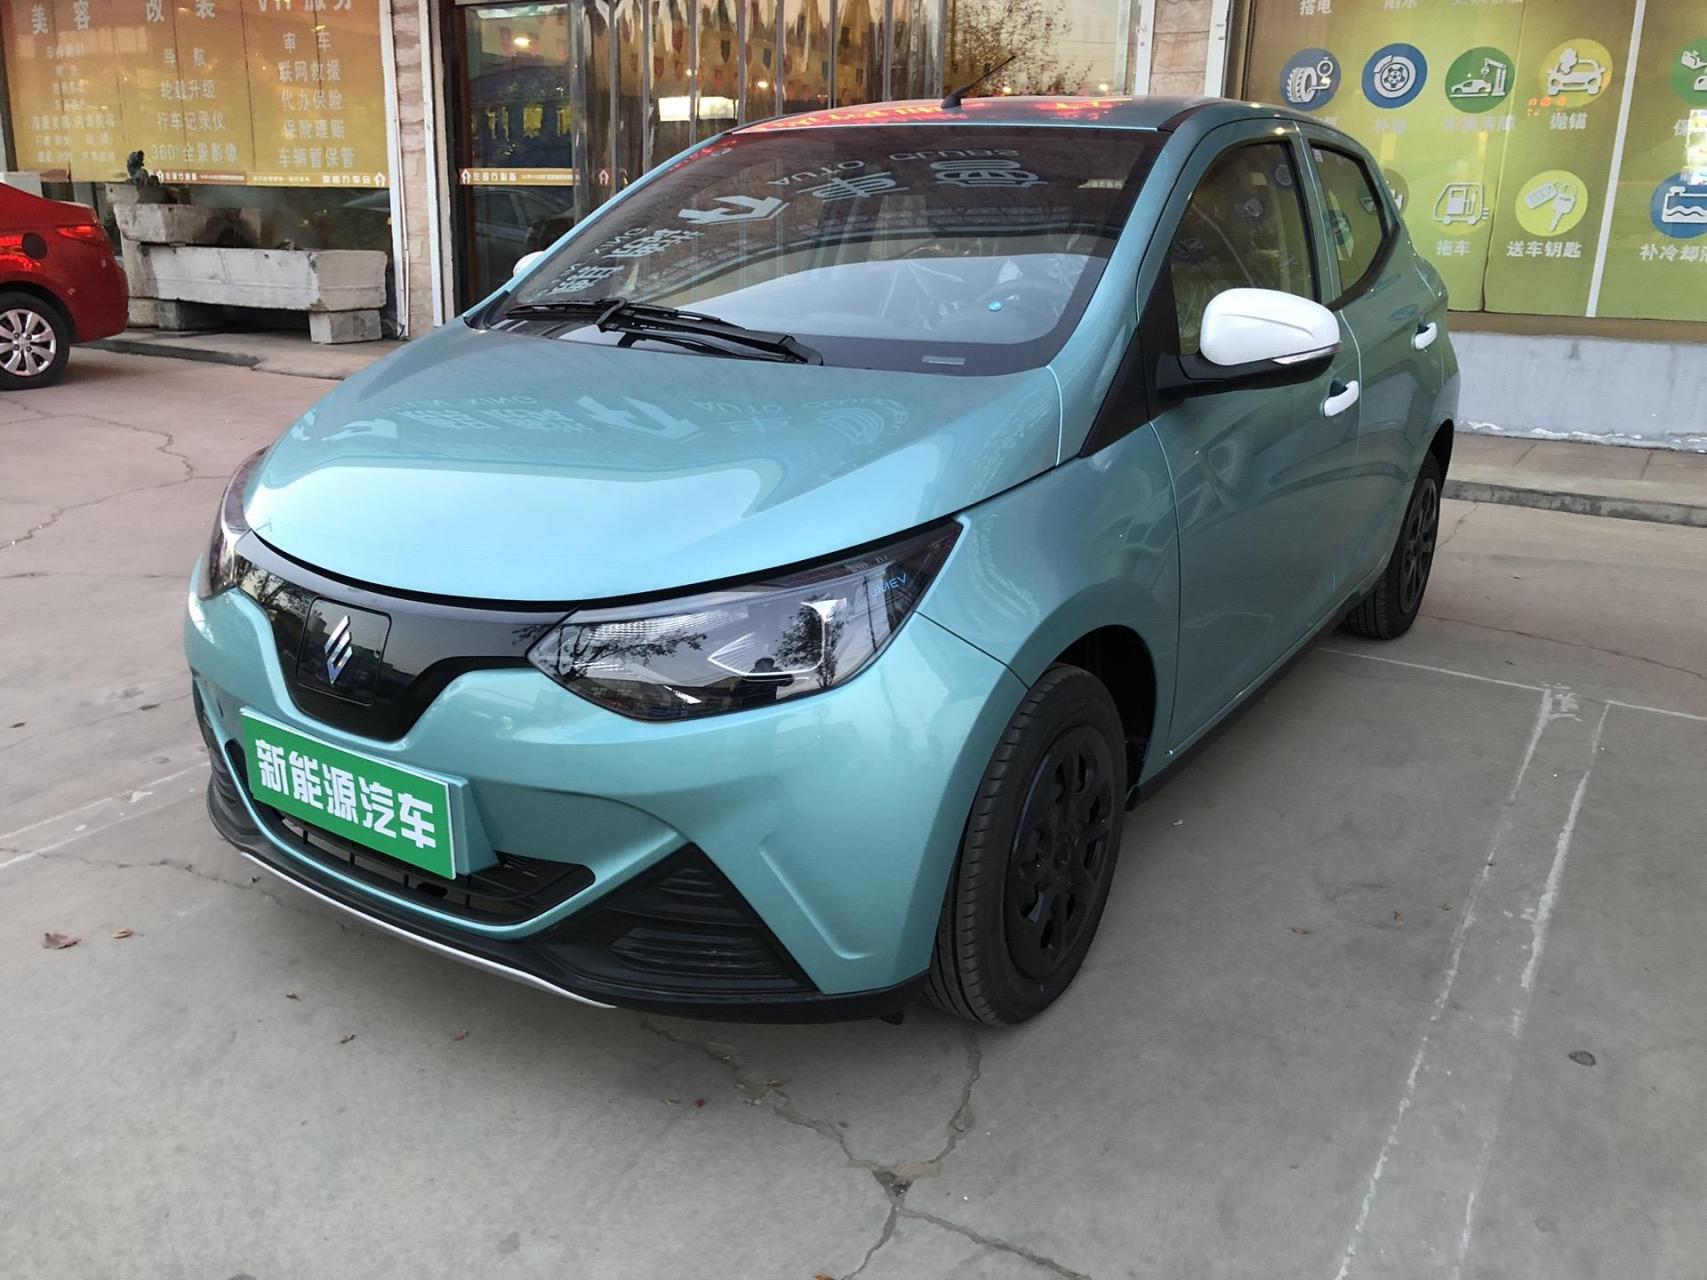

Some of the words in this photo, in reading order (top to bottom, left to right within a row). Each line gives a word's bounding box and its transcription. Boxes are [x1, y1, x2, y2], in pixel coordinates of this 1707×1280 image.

[156, 110, 226, 132] 行车记录仪
[1549, 112, 1588, 131] 抛锚
[1436, 239, 1471, 257] 拖车
[1506, 239, 1583, 260] 送车钥匙
[871, 572, 907, 597] JMEV
[255, 739, 437, 849] 新能源汽车
